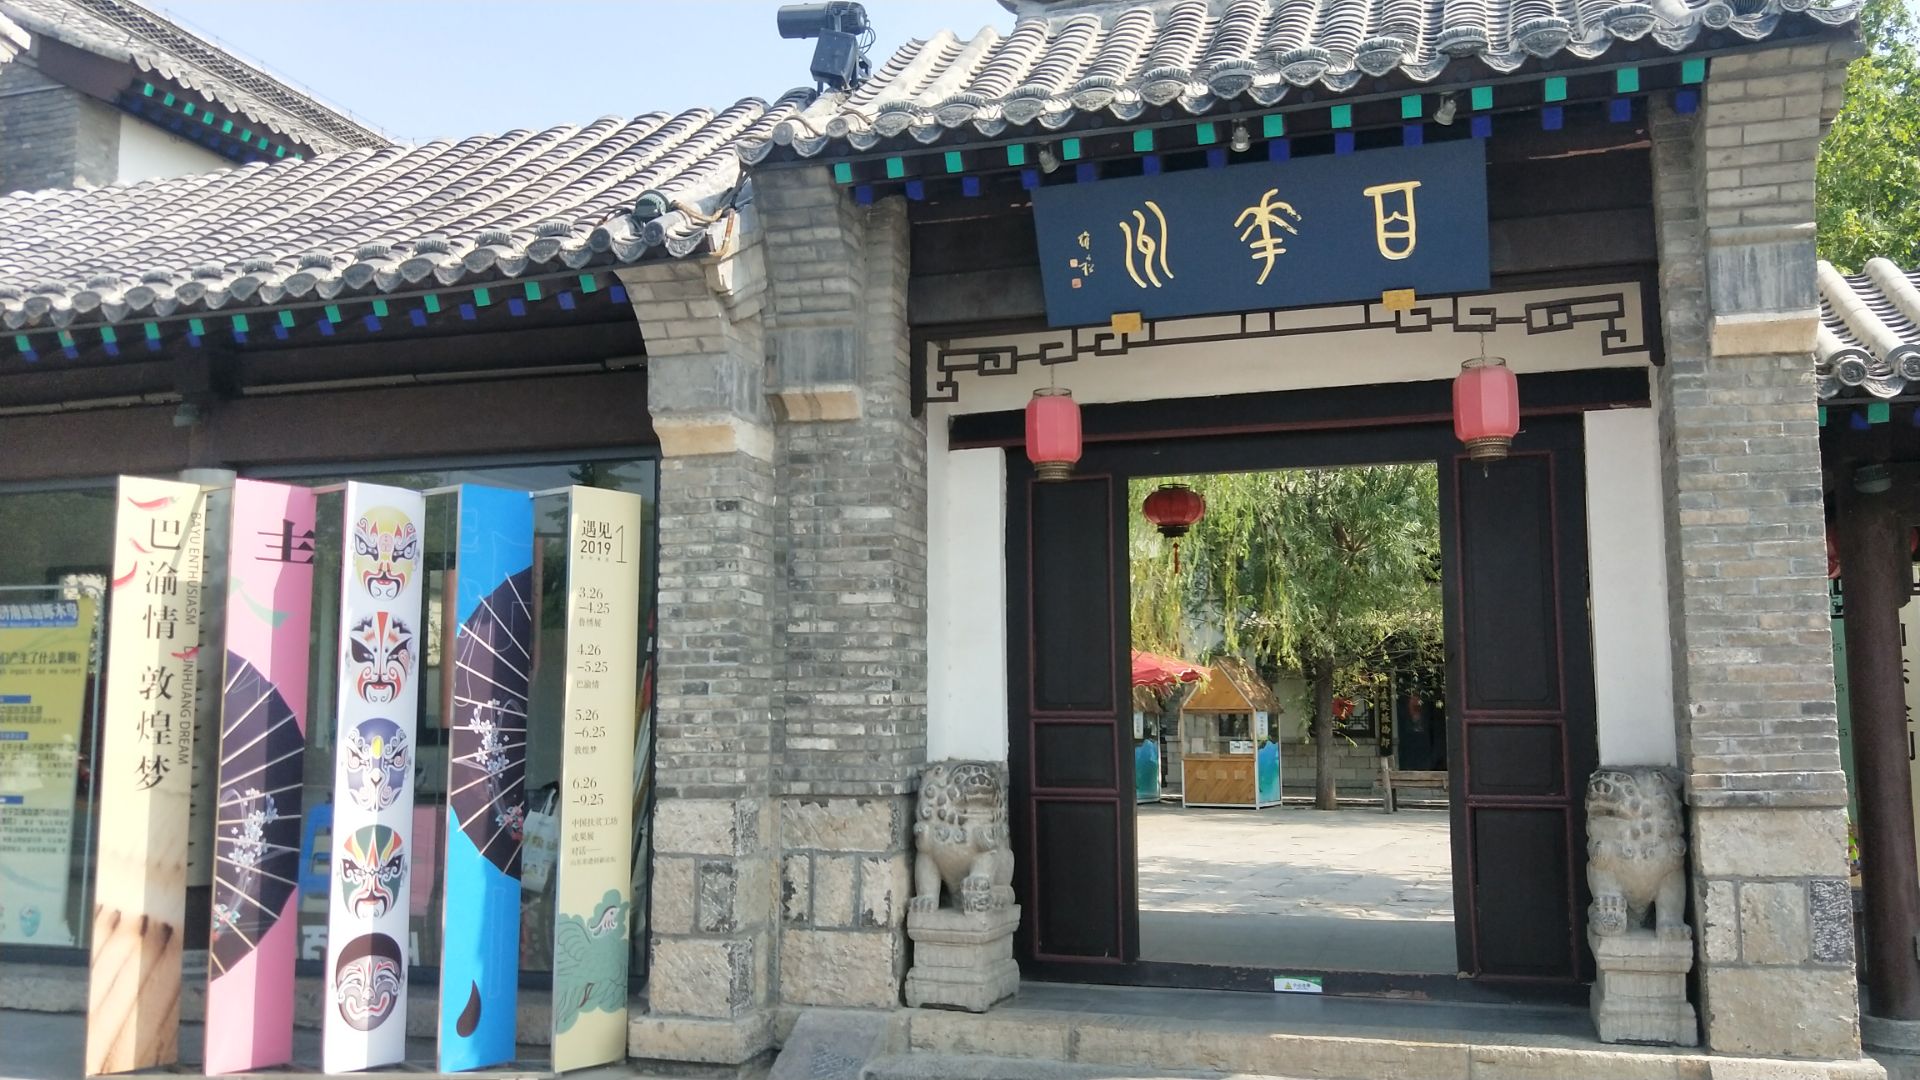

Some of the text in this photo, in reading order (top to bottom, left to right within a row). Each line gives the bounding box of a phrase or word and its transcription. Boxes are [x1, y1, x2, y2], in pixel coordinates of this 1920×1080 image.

[189, 512, 202, 545] BAYU
[581, 519, 612, 539] 遇见
[580, 539, 612, 555] 2019
[185, 547, 200, 626] ENTHUSIASM
[578, 586, 604, 599] 3.26
[135, 518, 181, 792] 巴渝情 敦煌梦
[576, 643, 602, 656] 4.26
[575, 709, 599, 721] 5.26
[178, 721, 191, 765] DREAM
[572, 776, 597, 789] 6.26
